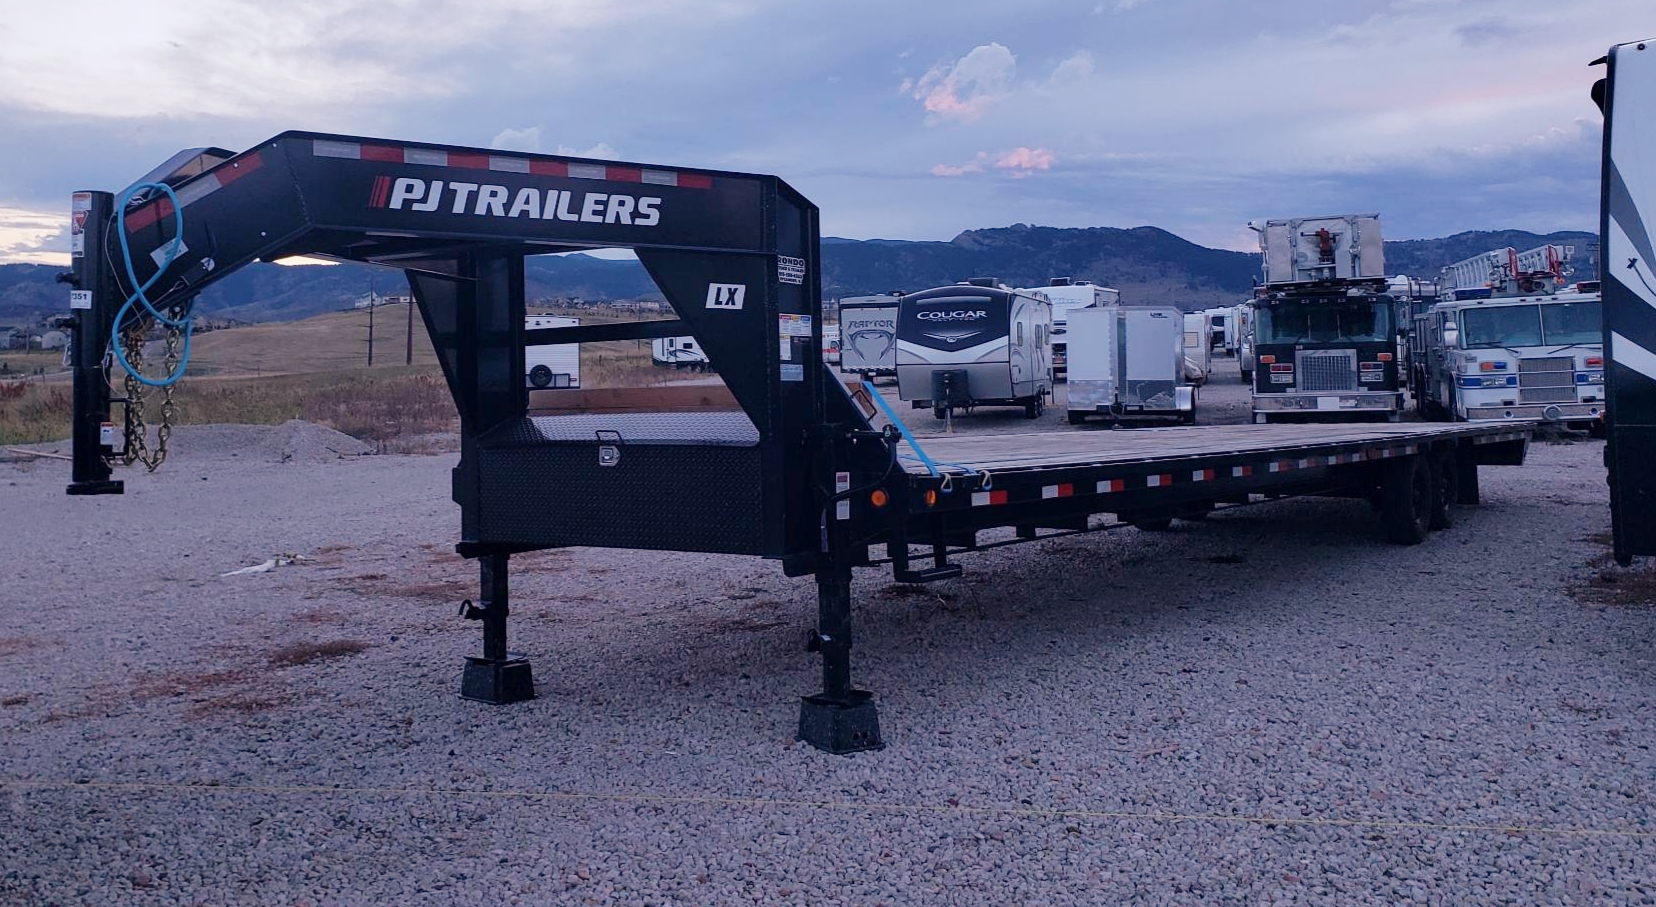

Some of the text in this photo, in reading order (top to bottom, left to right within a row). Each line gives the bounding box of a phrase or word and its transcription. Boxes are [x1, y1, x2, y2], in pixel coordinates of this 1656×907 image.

[389, 177, 662, 226] PJ TRAILERS
[714, 286, 739, 306] LX
[916, 310, 988, 320] COUGAR
[848, 320, 895, 329] RAPTOR
